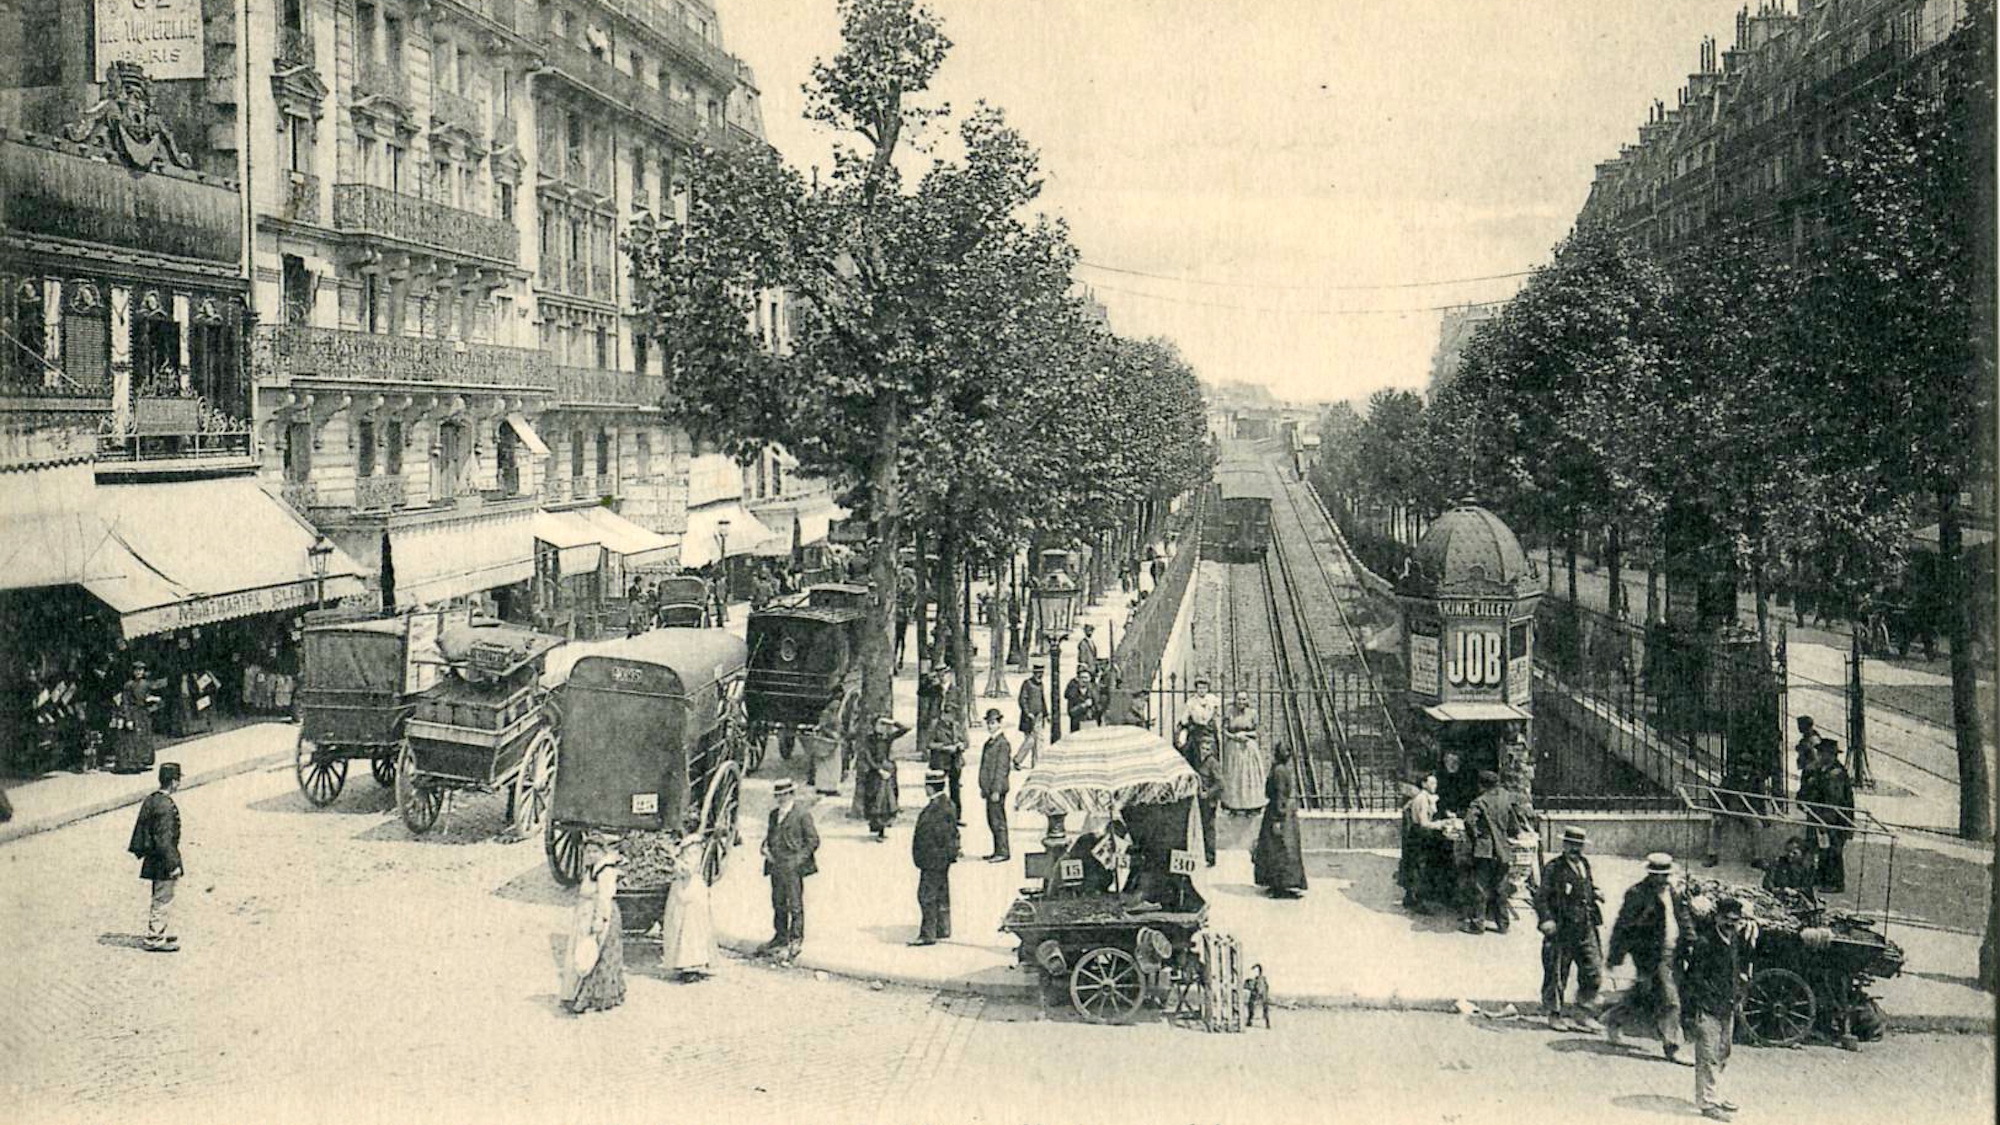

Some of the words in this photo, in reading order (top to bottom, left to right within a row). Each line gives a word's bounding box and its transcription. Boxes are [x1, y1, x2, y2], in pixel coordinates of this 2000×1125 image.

[118, 48, 181, 64] PARIS
[1447, 631, 1502, 685] JOB
[1065, 864, 1080, 877] 15
[1173, 859, 1195, 873] 30
